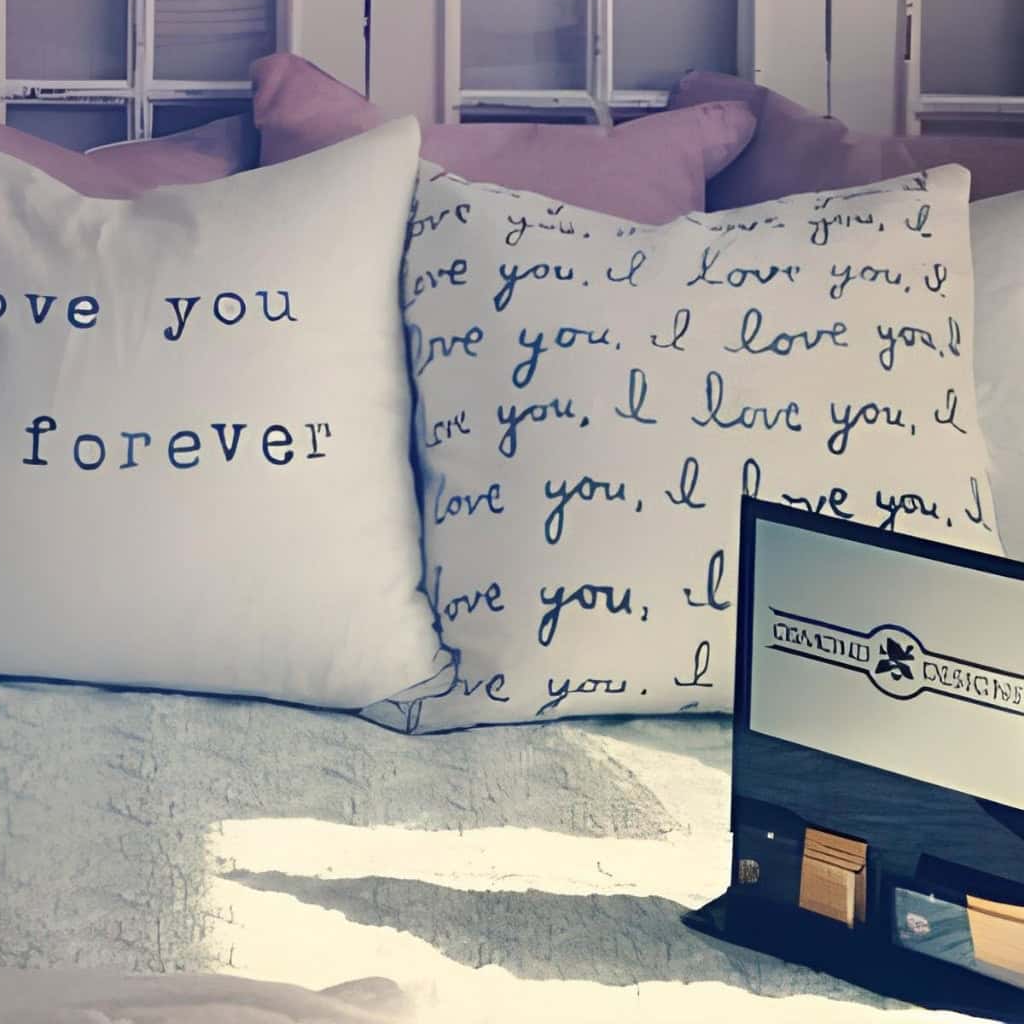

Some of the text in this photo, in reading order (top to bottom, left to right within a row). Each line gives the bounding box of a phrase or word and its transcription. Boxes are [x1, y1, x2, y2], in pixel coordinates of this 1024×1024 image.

[164, 289, 298, 341] you
[723, 307, 849, 356] love
[691, 370, 802, 432] love
[22, 414, 332, 471] forever
[433, 473, 505, 525] love
[432, 565, 505, 622] love
